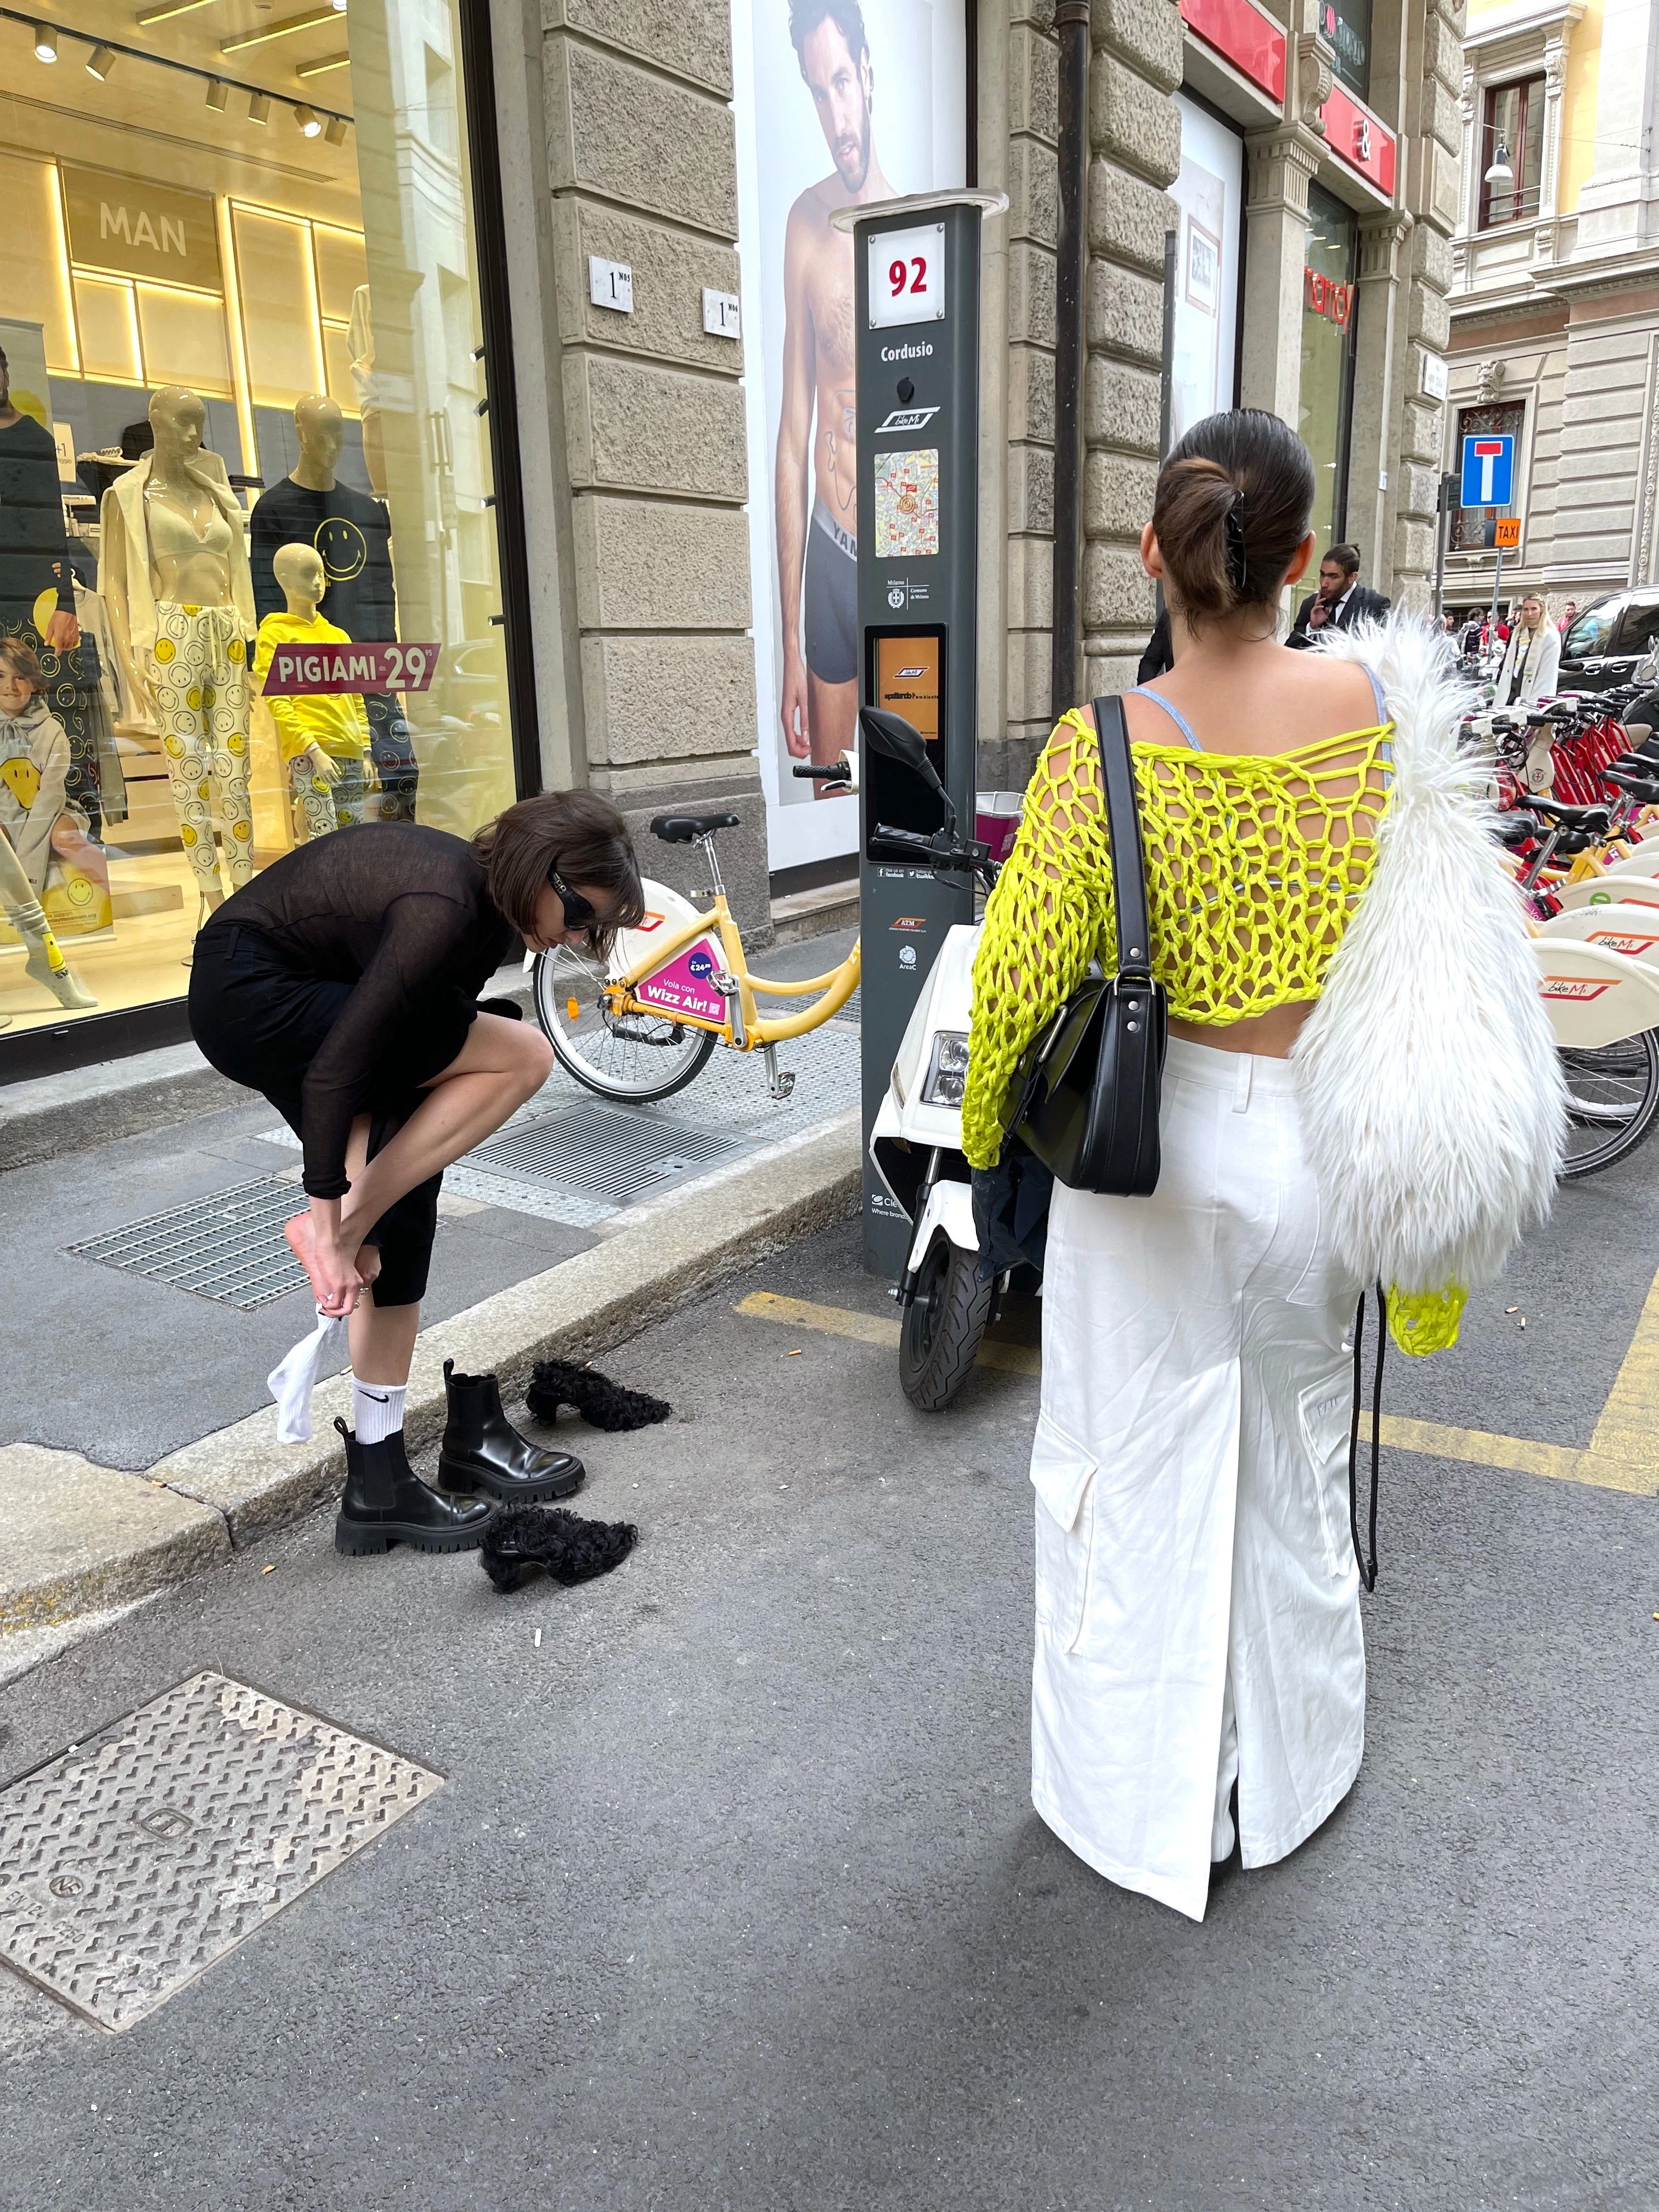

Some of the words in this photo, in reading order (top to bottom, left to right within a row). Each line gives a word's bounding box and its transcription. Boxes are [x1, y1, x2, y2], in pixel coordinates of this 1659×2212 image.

[100, 201, 187, 257] MAN
[609, 272, 617, 300] 1
[618, 271, 630, 283] N05
[889, 256, 927, 297] 92
[719, 301, 726, 327] 1
[881, 341, 933, 362] Cordusio
[1498, 526, 1519, 539] TAXI
[278, 655, 377, 682] PIGIAMI
[48, 913, 97, 923] mileymovement.org
[1599, 936, 1635, 950] bikeMi
[663, 979, 680, 990] Vola
[681, 985, 696, 994] con
[1548, 981, 1588, 995] bikeMi
[647, 985, 681, 1005] Wizz
[682, 996, 708, 1012] Air!
[871, 1207, 889, 1216] Where
[884, 1198, 898, 1208] Cle
